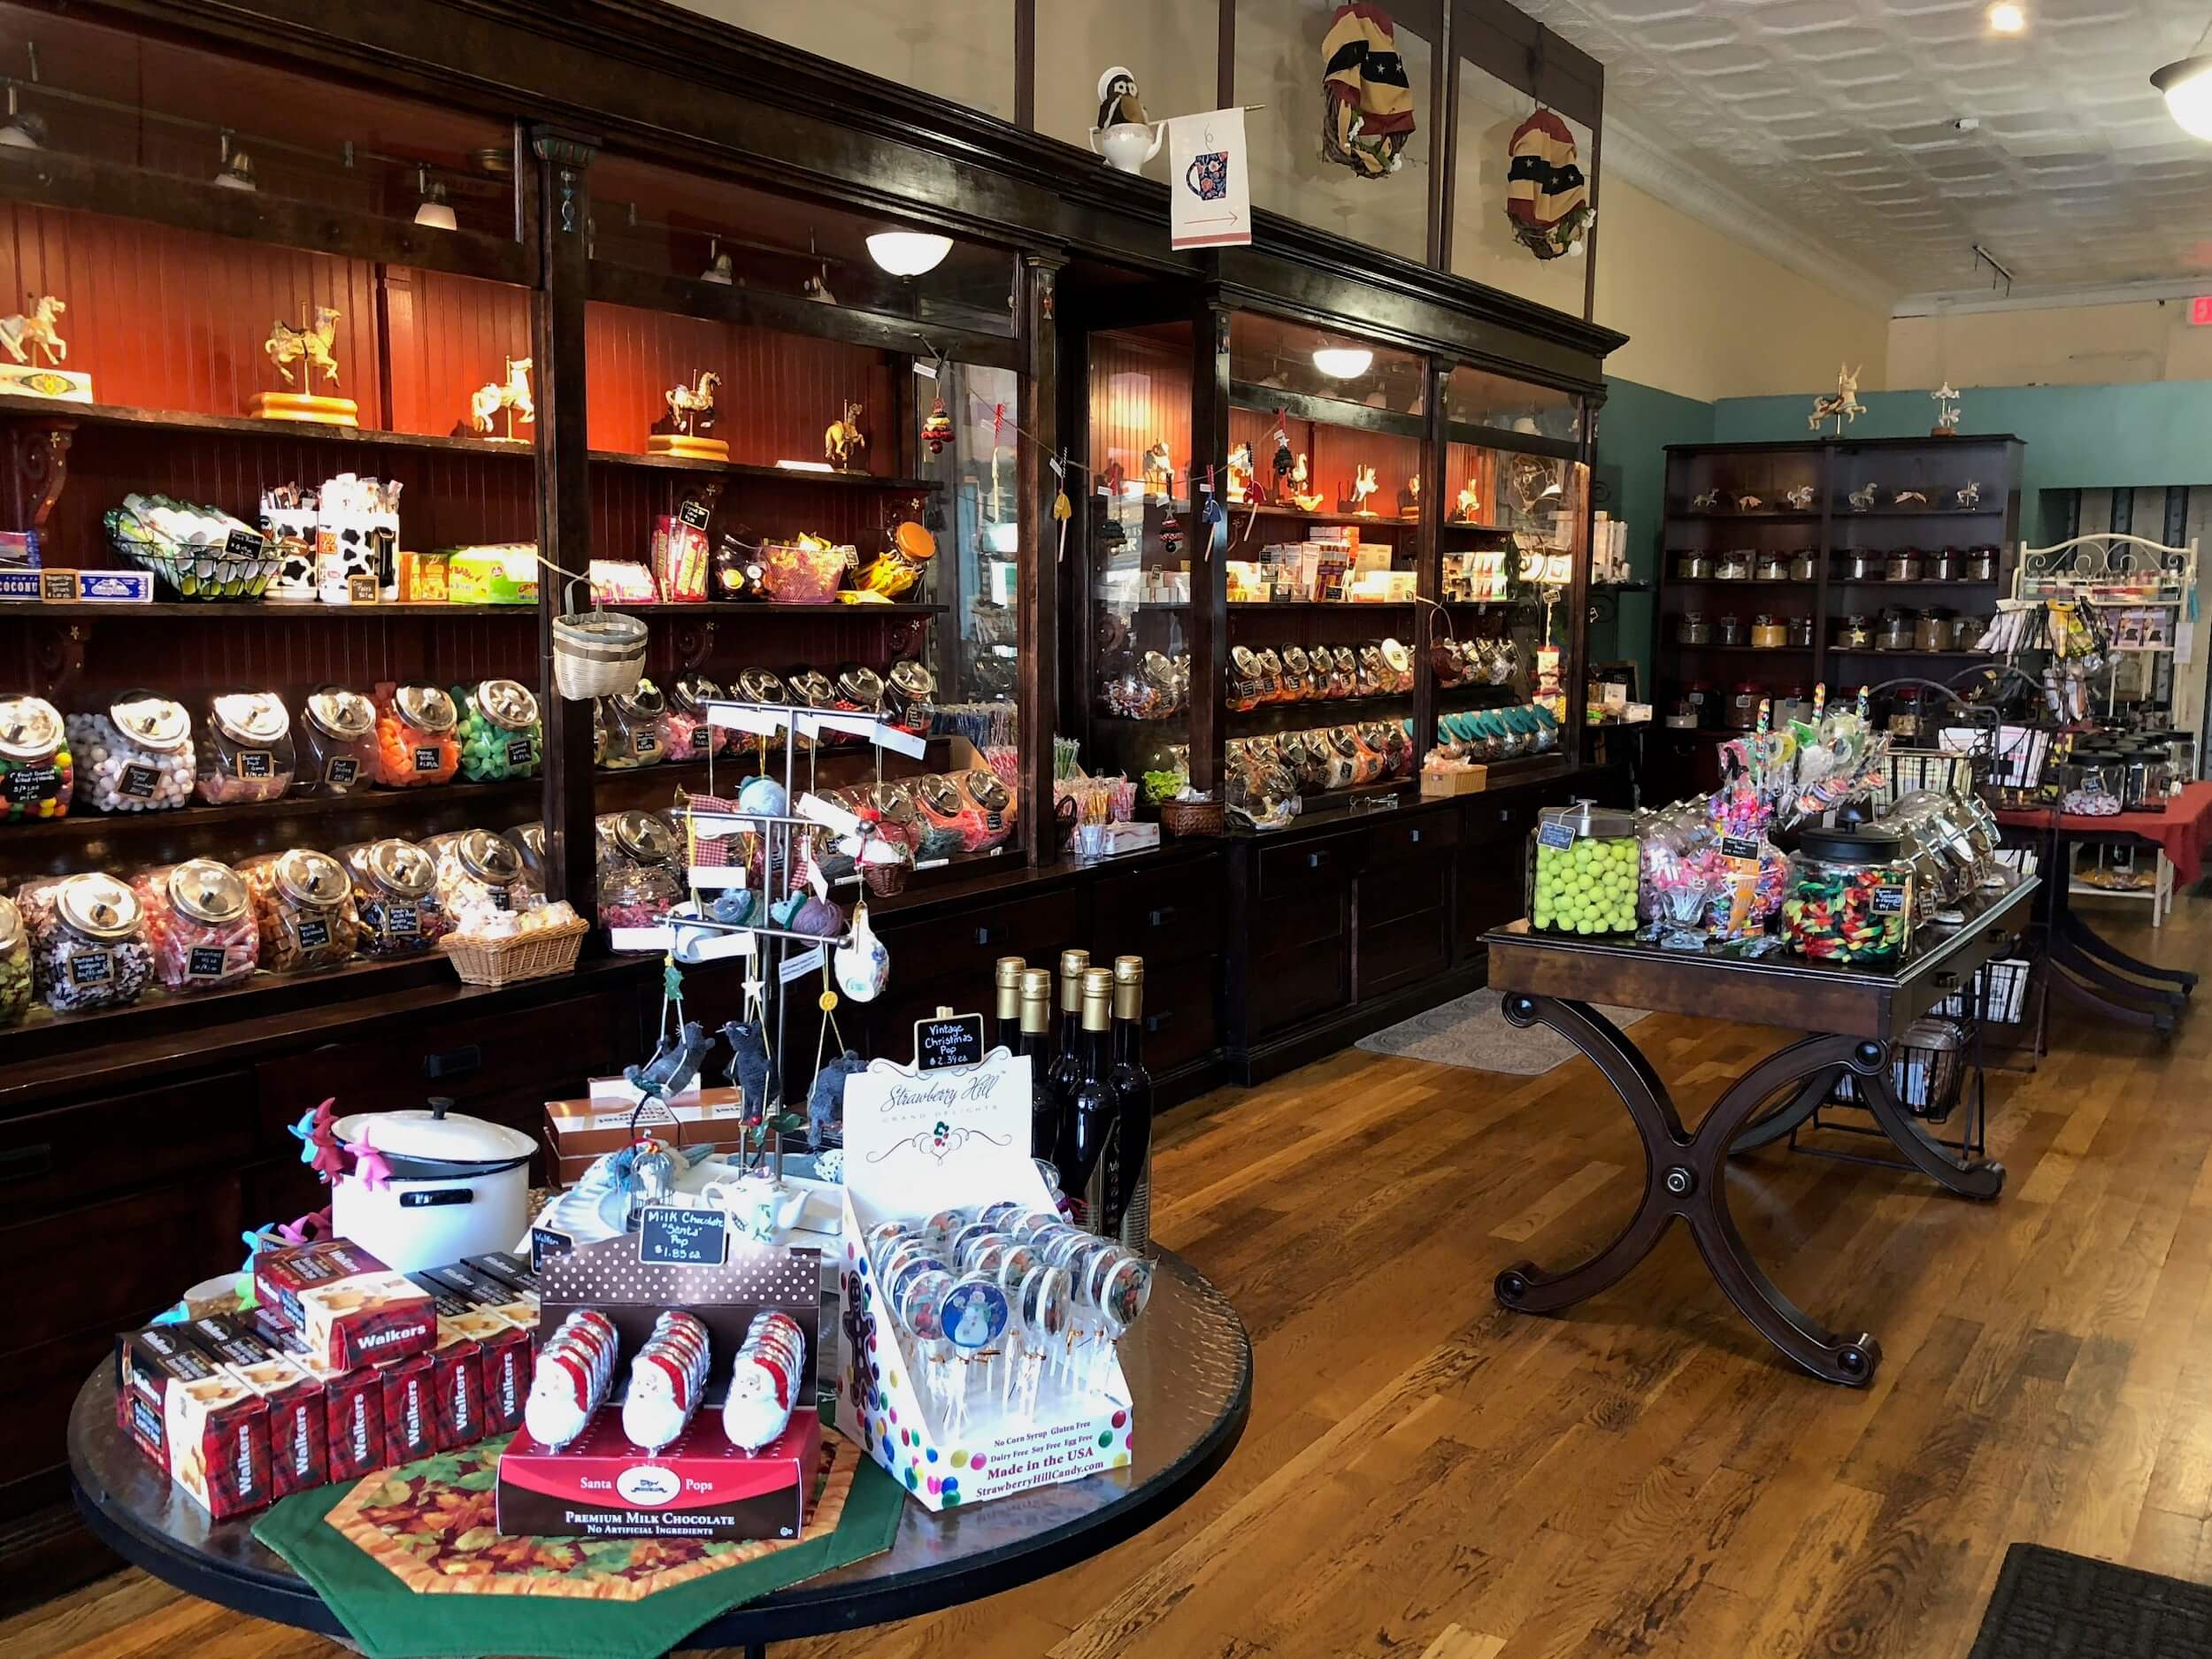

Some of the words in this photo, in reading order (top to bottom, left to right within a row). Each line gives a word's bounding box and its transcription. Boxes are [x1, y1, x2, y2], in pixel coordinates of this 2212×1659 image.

[925, 1033, 973, 1049] Christmas
[929, 1024, 964, 1037] Vintage
[940, 1045, 956, 1056] Pop
[880, 1081, 957, 1112] Strawberry
[961, 1072, 1000, 1101] Hill
[671, 1235, 688, 1248] Pop
[357, 1324, 426, 1350] Walkers
[455, 1364, 468, 1431] Walkers
[503, 1351, 514, 1417] Walkers
[353, 1393, 367, 1463] Walkers
[408, 1379, 421, 1448] Walkers
[295, 1405, 309, 1477] Walkers
[990, 1453, 1011, 1463] Dairy
[1012, 1448, 1029, 1458] Free
[1032, 1445, 1044, 1455] Soy
[1046, 1440, 1061, 1450] Free
[1064, 1436, 1077, 1447] Egg
[1078, 1433, 1094, 1443] Free
[994, 1439, 1005, 1448] No
[1006, 1436, 1025, 1445] Corn
[1025, 1430, 1048, 1442] Syrup
[1050, 1425, 1075, 1435] Gluten
[1076, 1420, 1091, 1430] Free
[237, 1425, 253, 1497] Walkers
[987, 1463, 1024, 1480] Made
[1026, 1460, 1040, 1471] in
[1043, 1453, 1064, 1468] the
[1067, 1446, 1094, 1462] USA
[580, 1477, 611, 1490] Santa
[685, 1479, 713, 1494] Pops
[976, 1460, 1105, 1498] StrawberryHillCandy.com
[565, 1510, 622, 1525] PREMIUM
[626, 1511, 659, 1525] MILK
[663, 1512, 735, 1525] CHOCOLATE
[604, 1525, 653, 1535] ARTIFICIAL
[656, 1525, 713, 1536] INGREDIENTS
